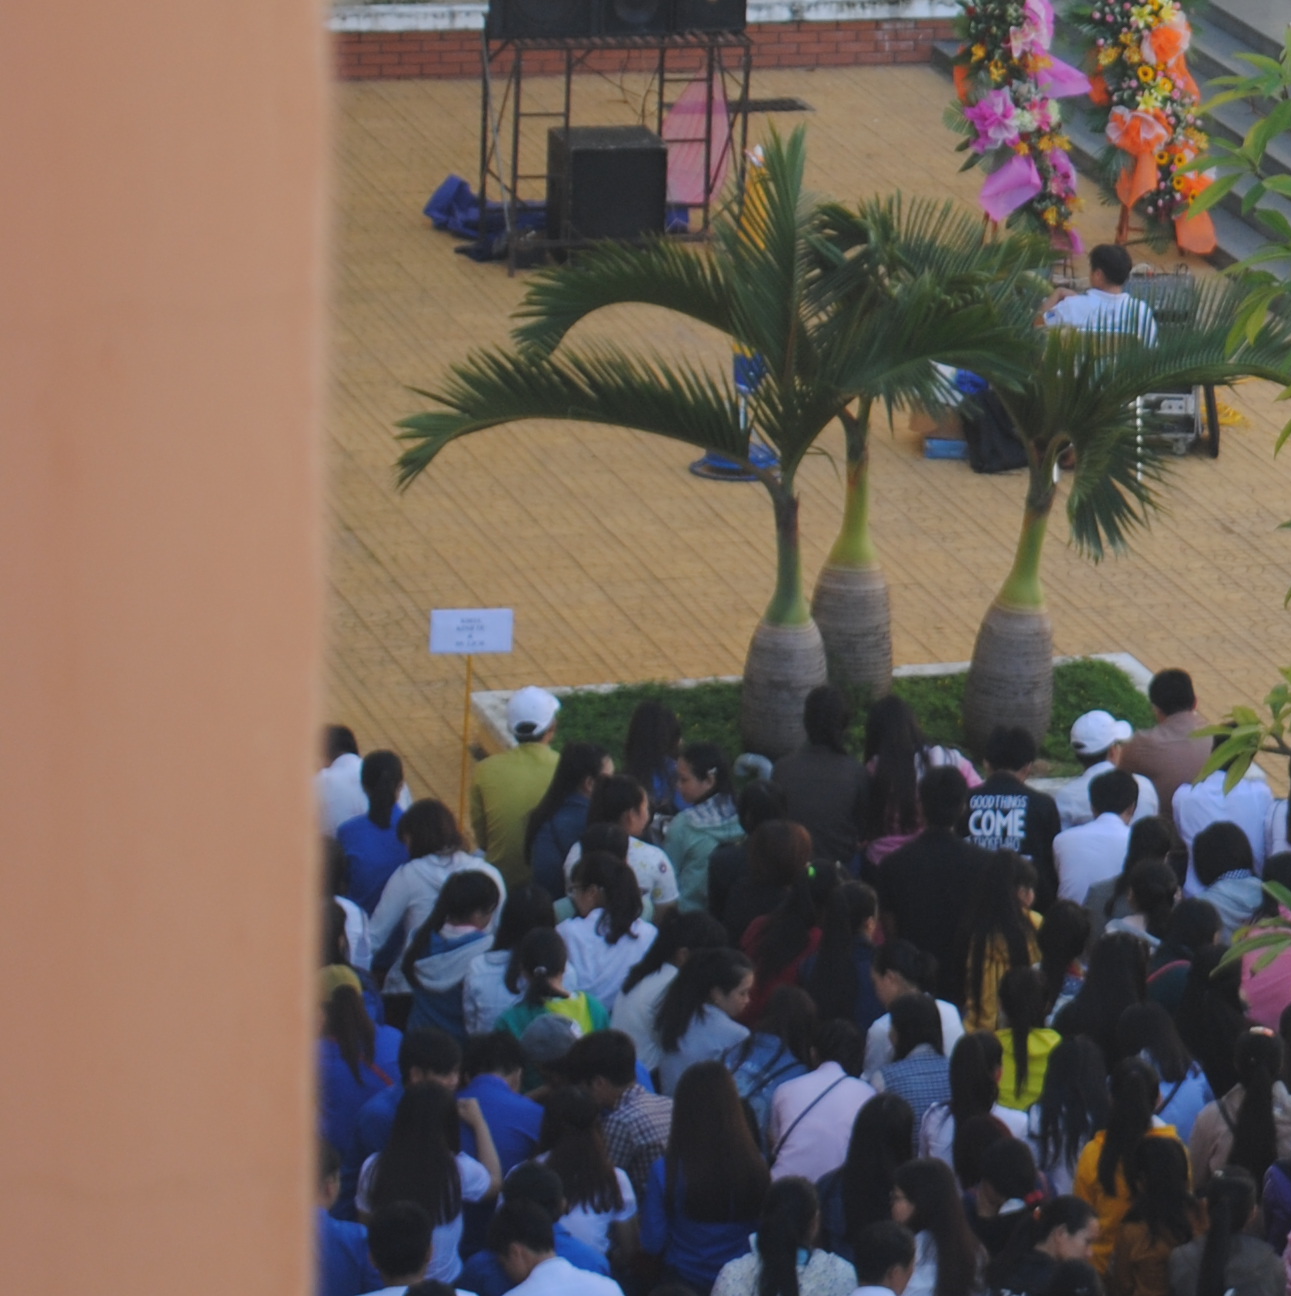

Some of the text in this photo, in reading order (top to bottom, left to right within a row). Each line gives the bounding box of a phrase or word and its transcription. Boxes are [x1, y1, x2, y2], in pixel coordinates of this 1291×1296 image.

[969, 795, 1029, 809] GOOD THINGS
[968, 809, 1025, 836] COME
